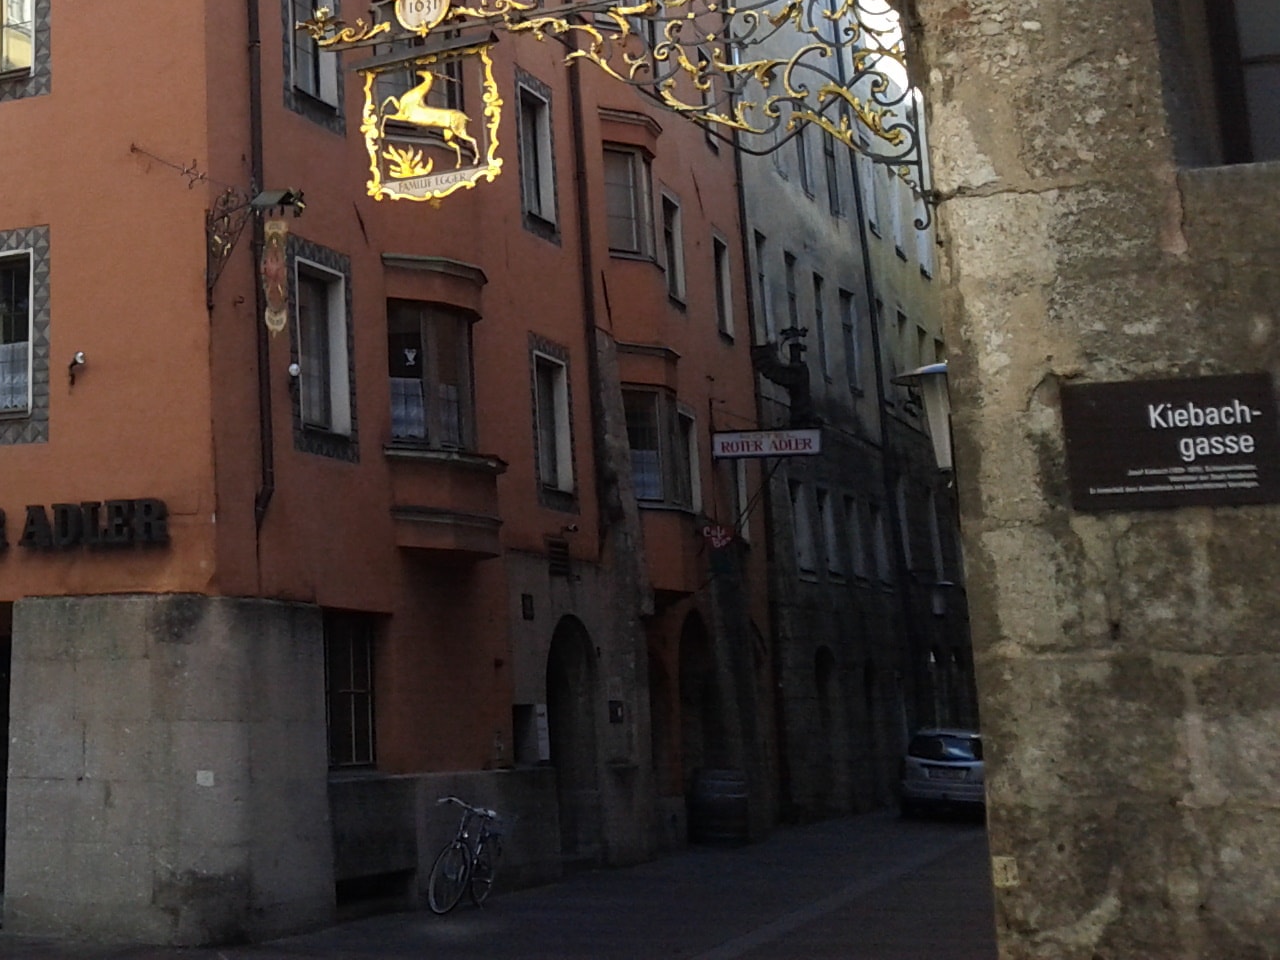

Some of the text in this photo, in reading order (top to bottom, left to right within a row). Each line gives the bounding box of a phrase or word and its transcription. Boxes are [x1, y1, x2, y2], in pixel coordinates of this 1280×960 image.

[1148, 399, 1262, 428] Kiebach-
[721, 438, 813, 453] ROTER ADLER
[1179, 434, 1255, 461] gasse
[19, 498, 171, 548] ADLER
